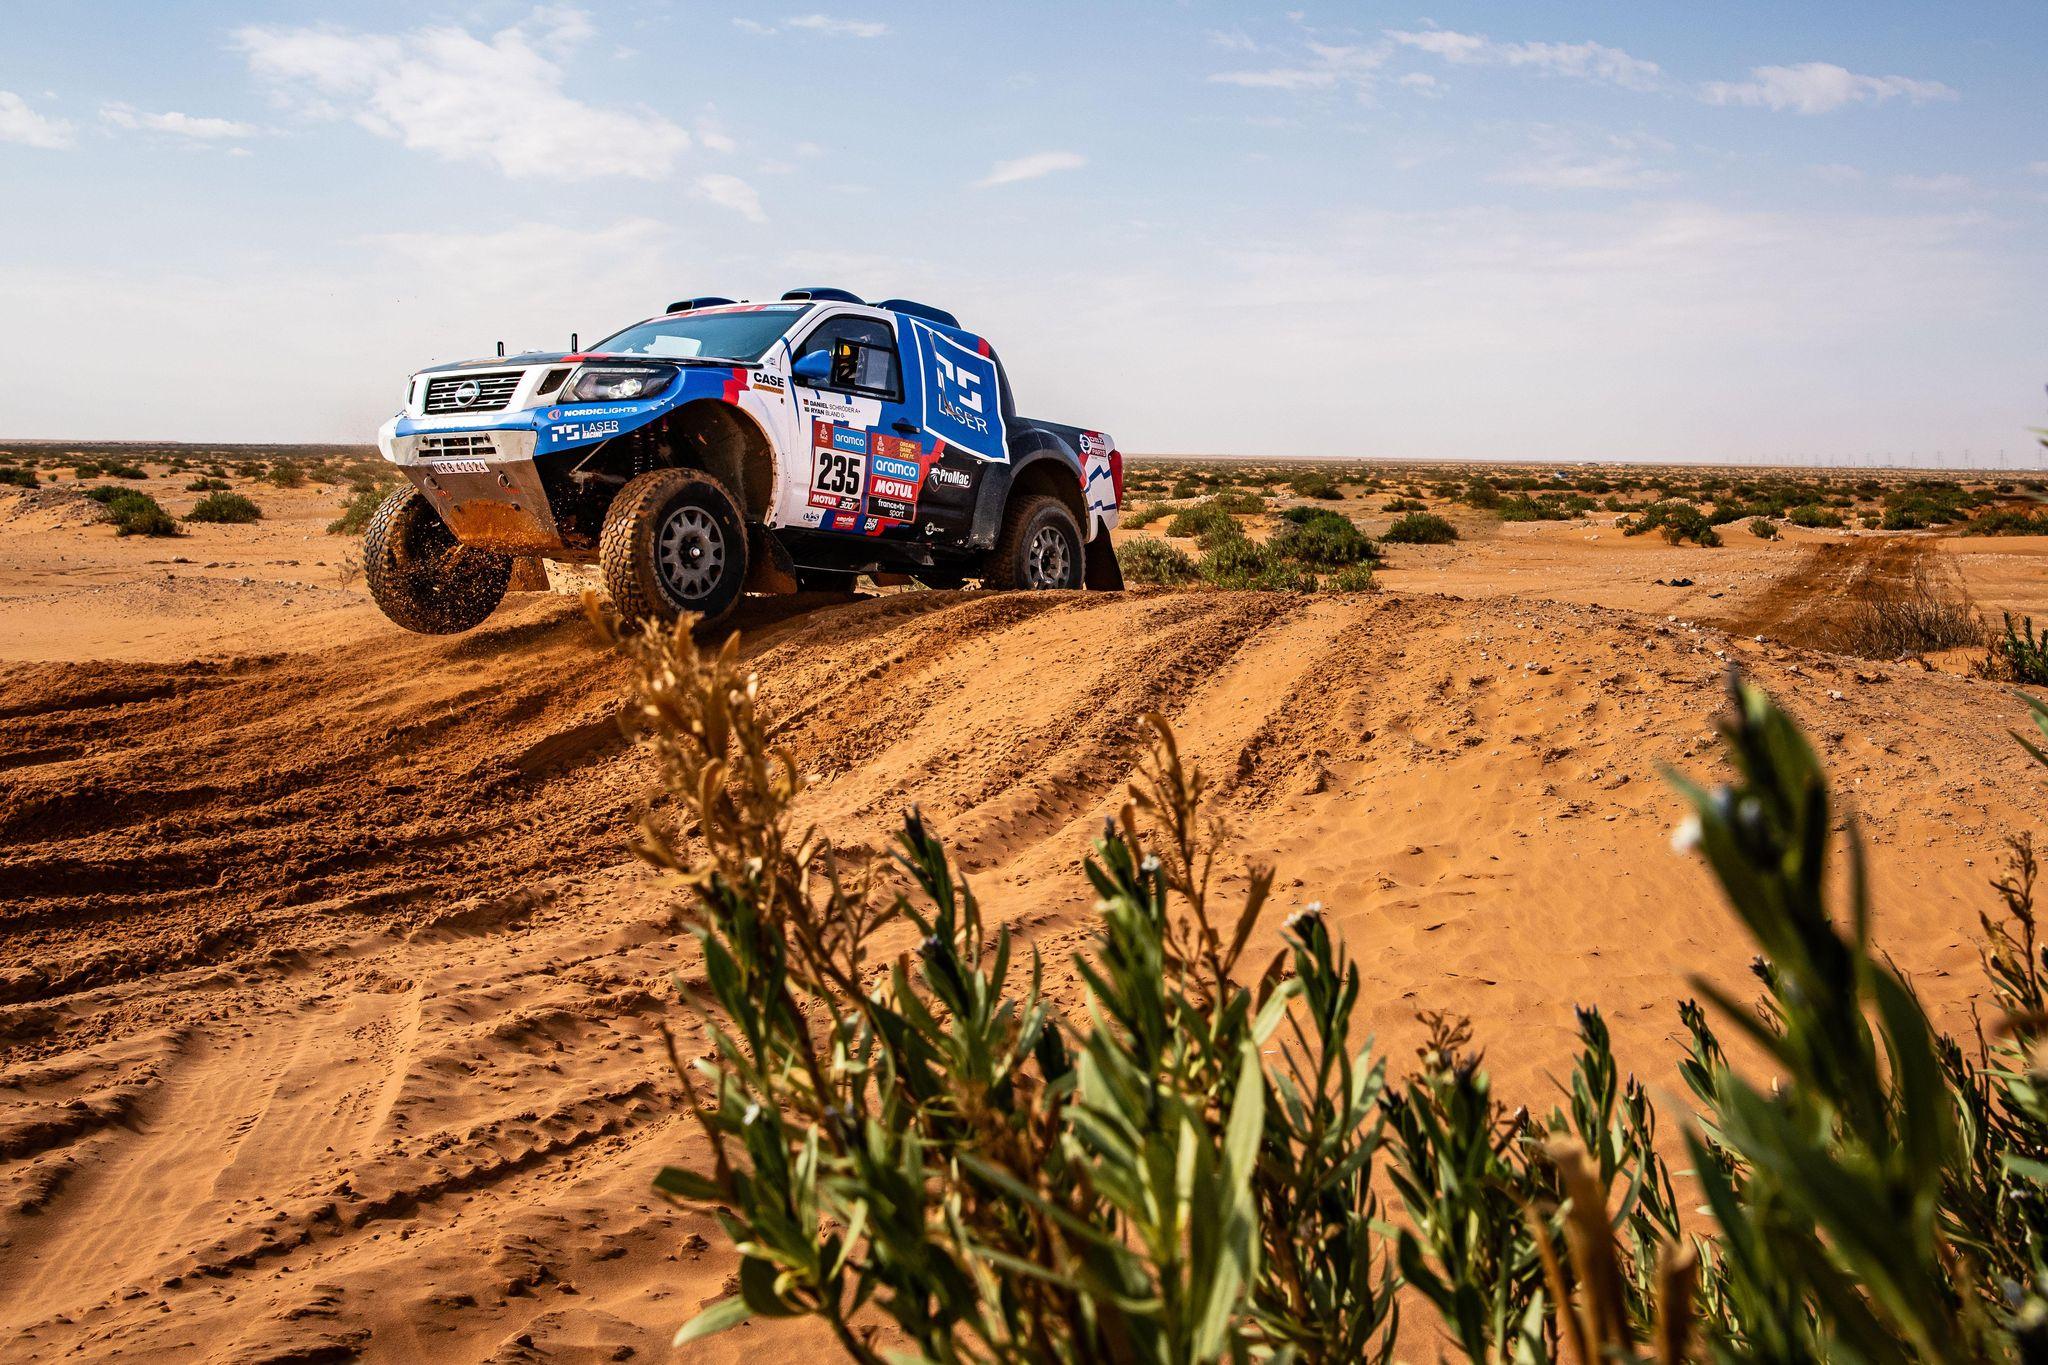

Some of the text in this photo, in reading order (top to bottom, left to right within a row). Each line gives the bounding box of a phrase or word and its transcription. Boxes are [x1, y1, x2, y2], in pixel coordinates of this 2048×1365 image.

[753, 372, 785, 388] CASE
[809, 400, 828, 409] DANIEL
[564, 406, 638, 417] NORDICLIGHTS
[810, 407, 825, 416] RYAN
[825, 410, 841, 418] BLAND
[938, 393, 989, 435] LASER
[581, 420, 619, 433] LASER
[835, 433, 865, 447] aramco
[433, 462, 456, 475] NRB
[817, 452, 861, 495] 235
[875, 459, 916, 478] aramco
[939, 469, 970, 486] ProMac
[874, 479, 913, 498] MOTUL
[812, 494, 837, 506] MOTUL
[889, 509, 905, 518] sport
